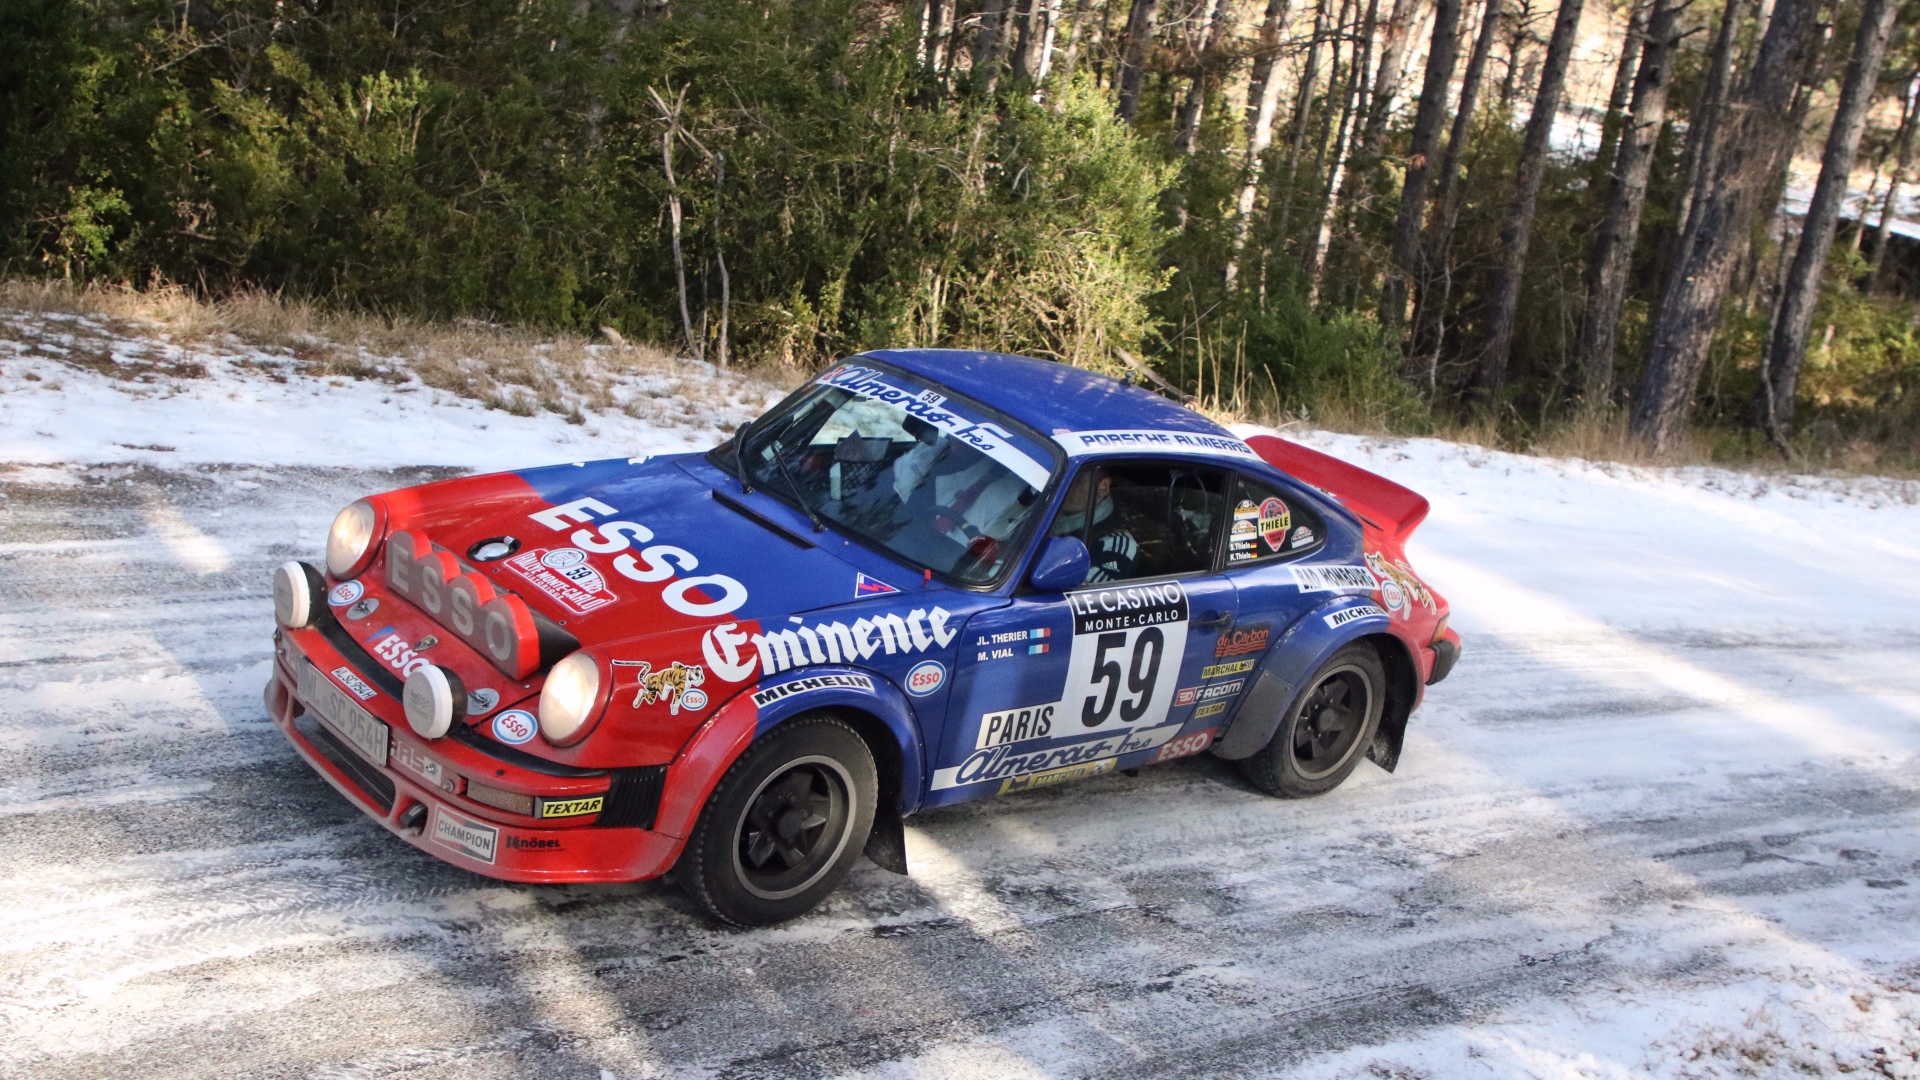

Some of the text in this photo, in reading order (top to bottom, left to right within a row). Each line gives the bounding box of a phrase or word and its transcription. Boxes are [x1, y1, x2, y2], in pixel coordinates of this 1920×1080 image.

[922, 391, 941, 404] 59
[1079, 433, 1173, 448] PORSCHE
[1260, 516, 1289, 532] THIELE
[527, 496, 748, 617] ESSO
[511, 551, 546, 575] RALLYE
[539, 571, 607, 610] MONTE-CARLO
[565, 566, 593, 580] 59
[522, 571, 565, 600] HISTORIQUE
[392, 543, 511, 661] ESSO
[1073, 584, 1181, 616] LE CASINO
[1332, 607, 1386, 626] MICHELIN
[701, 605, 958, 683] Eminence
[976, 630, 1028, 646] JL. THERIER
[1232, 628, 1268, 645] Carbon
[977, 648, 1014, 662] M. VIAL
[1081, 626, 1164, 728] 59
[1203, 664, 1239, 677] MARCHAL
[754, 676, 872, 706] MICHELIN
[1196, 682, 1240, 700] FACOM
[1197, 703, 1226, 716] TEXTAR
[330, 692, 346, 728] SC
[350, 711, 385, 764] 954H
[985, 706, 1054, 747] PARIS
[1158, 732, 1209, 761] ESSO
[1035, 767, 1086, 786] MARCHAL
[545, 800, 601, 815] TEXTAR
[438, 819, 491, 851] CHAMPION
